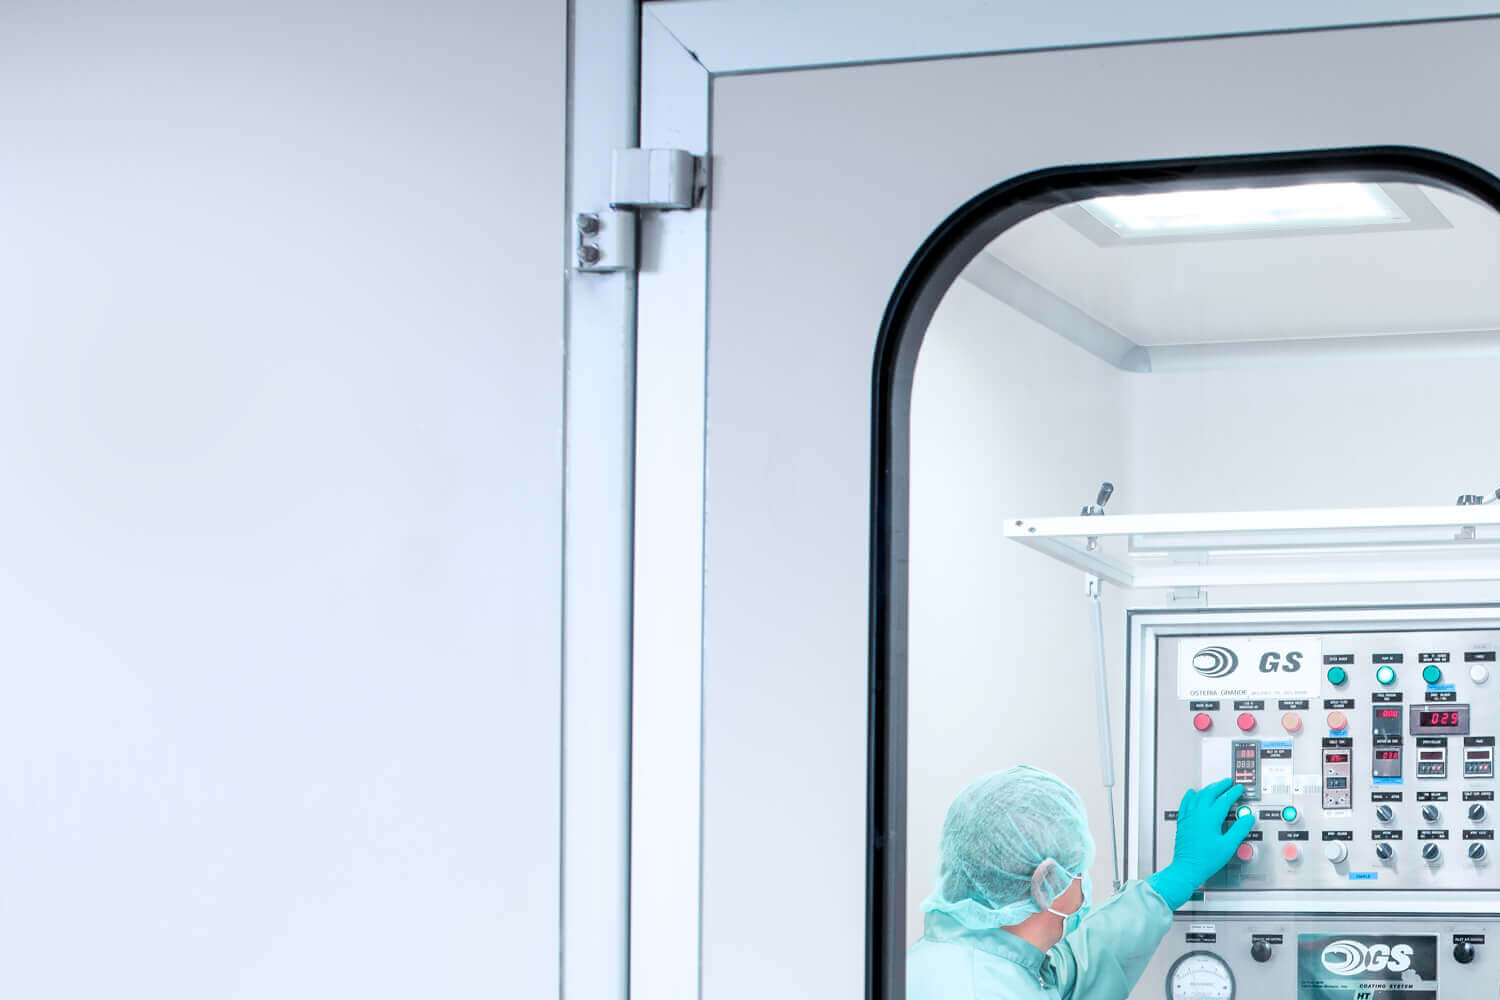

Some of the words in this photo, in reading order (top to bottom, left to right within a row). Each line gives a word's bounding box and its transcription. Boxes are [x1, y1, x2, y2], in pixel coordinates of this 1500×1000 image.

[1258, 651, 1305, 673] GS
[1366, 943, 1415, 972] GS
[1356, 992, 1372, 1000] HT
